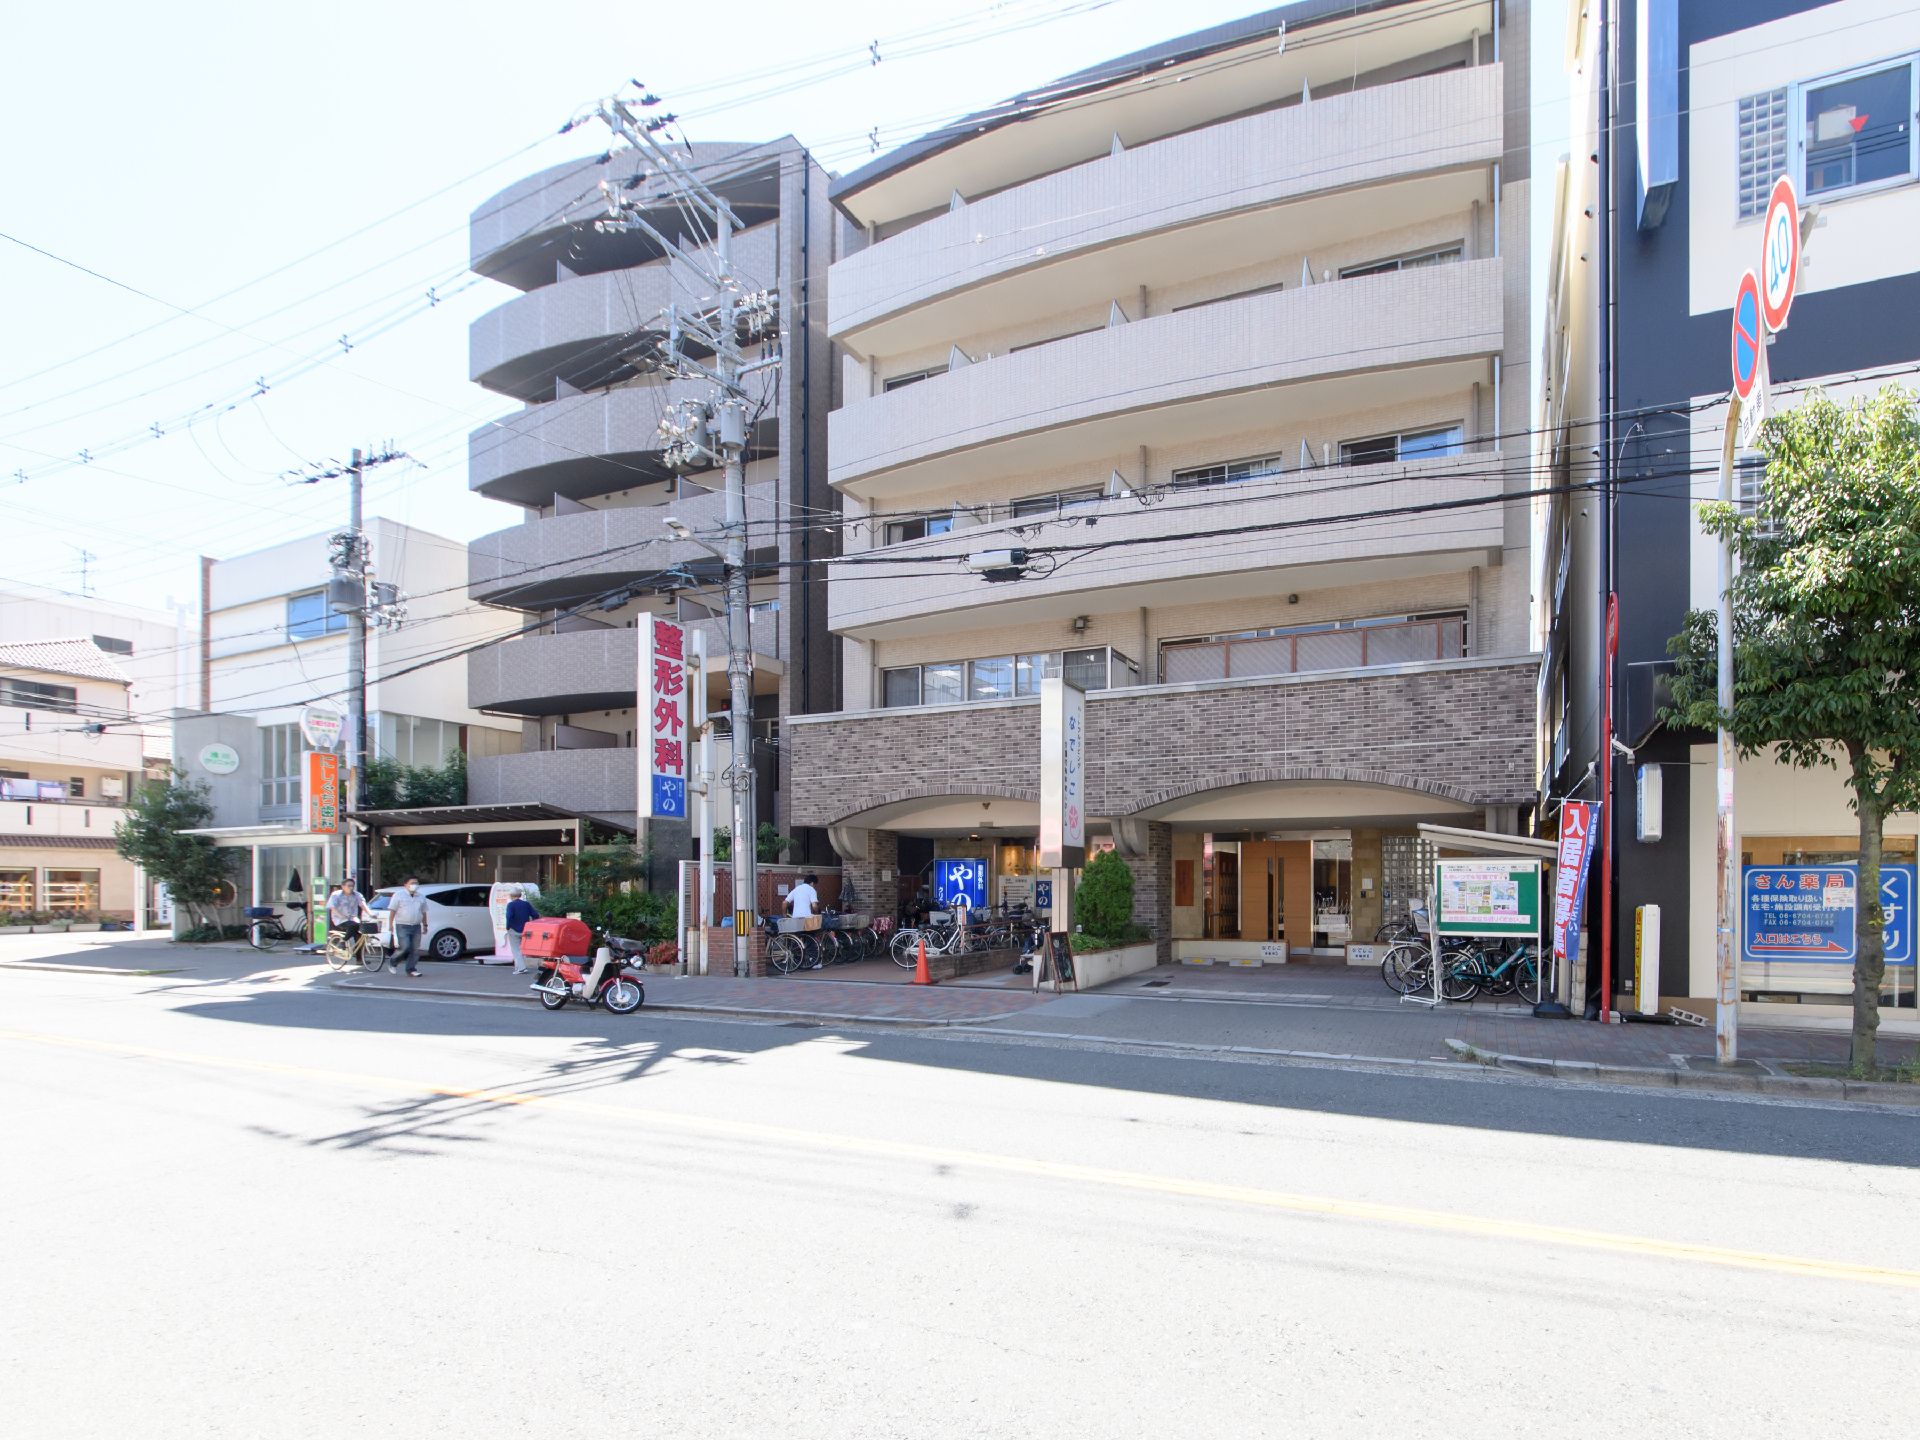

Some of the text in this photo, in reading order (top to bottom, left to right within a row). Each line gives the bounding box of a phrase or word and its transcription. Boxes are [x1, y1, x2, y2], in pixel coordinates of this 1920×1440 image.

[1770, 215, 1790, 295] 40
[654, 620, 684, 776] 整形外科
[1068, 715, 1076, 797] なでしこ
[661, 780, 677, 812] やの
[948, 862, 973, 912] やの
[1037, 883, 1049, 906] やの
[1554, 808, 1585, 954] 入居者募集
[1754, 873, 1846, 890] さん薬局
[1753, 933, 1823, 945] 入口はこちら
[1881, 876, 1904, 951] くすり
